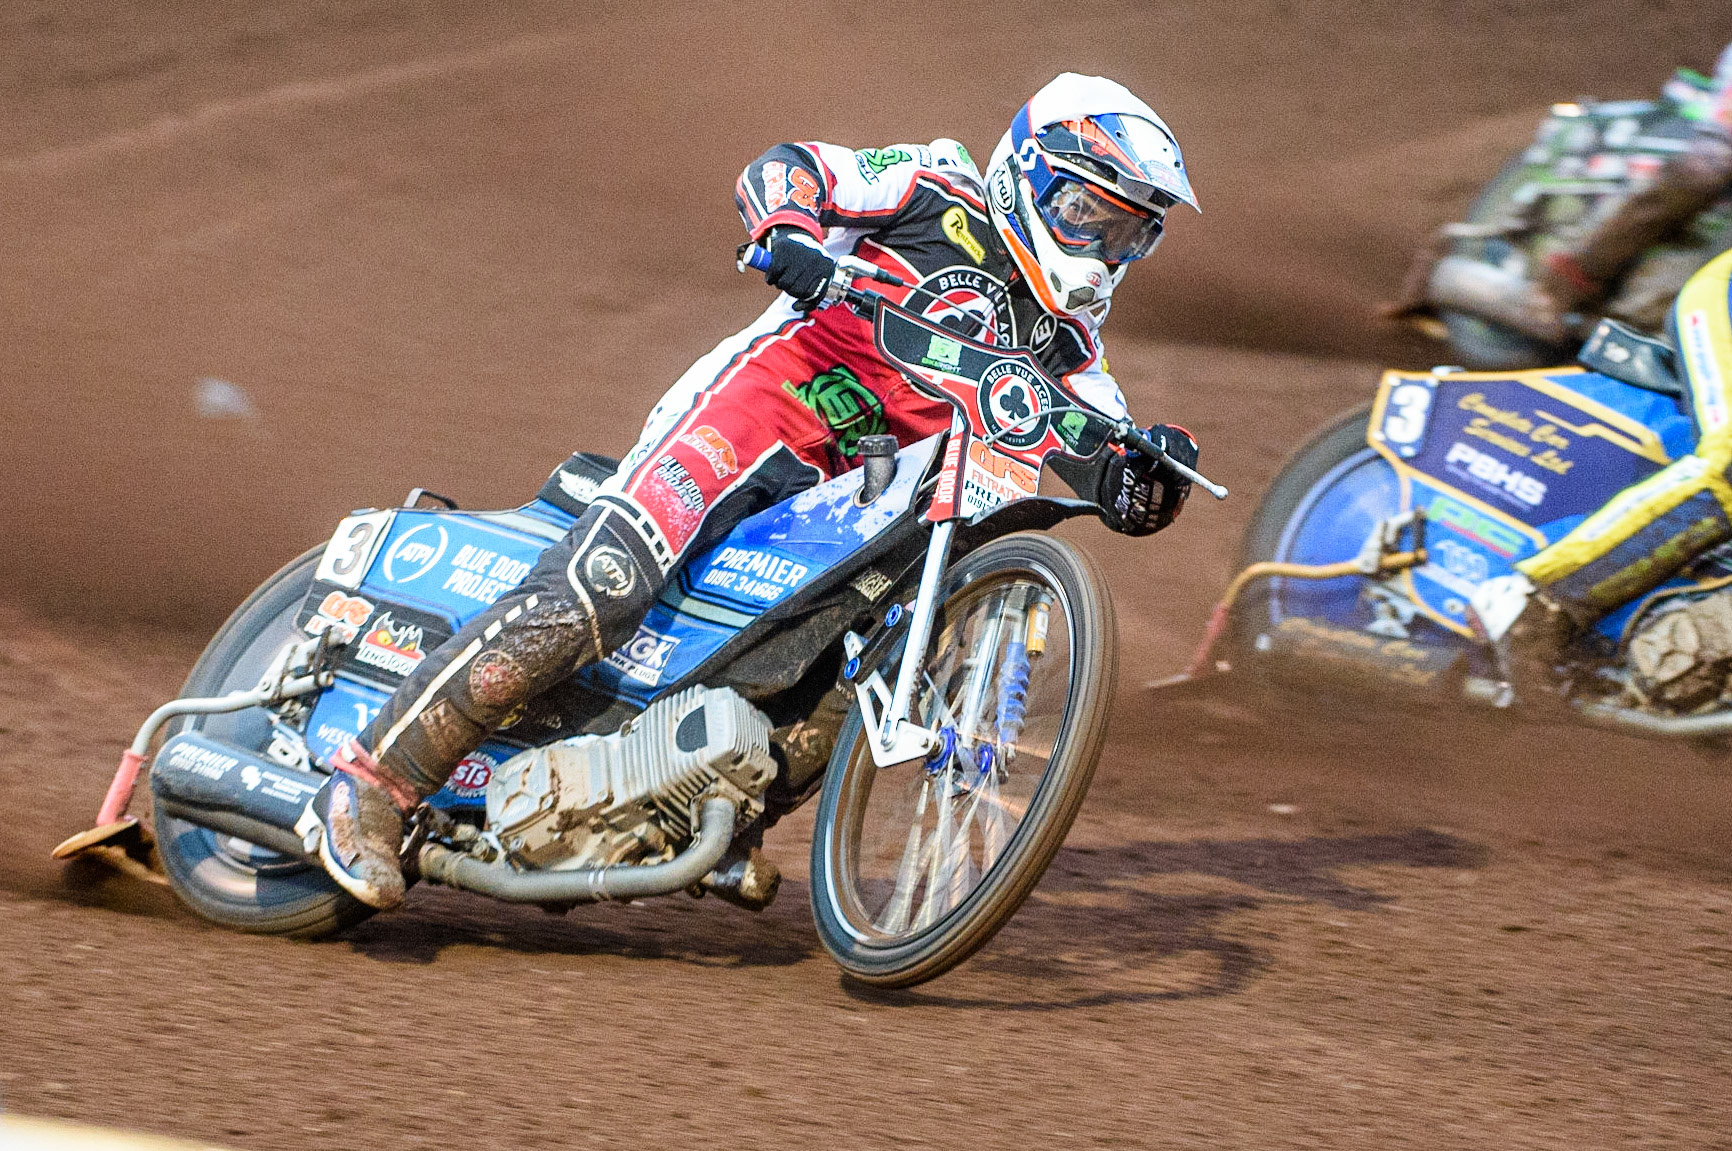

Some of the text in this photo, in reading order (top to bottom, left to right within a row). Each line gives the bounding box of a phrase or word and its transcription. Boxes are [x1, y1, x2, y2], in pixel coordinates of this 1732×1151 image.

[938, 273, 982, 291] BELLE
[986, 364, 1049, 412] BELLE VUE ACES
[1385, 385, 1431, 443] 3
[658, 455, 705, 513] BLUE DOOR
[938, 438, 961, 504] BLUE DOOR
[971, 469, 1026, 503] FILTRATIO
[333, 523, 374, 575] 3
[451, 544, 531, 586] BLUE DOO
[711, 547, 808, 587] PREMIER
[595, 555, 628, 589] ATPI
[733, 575, 784, 601] 341666
